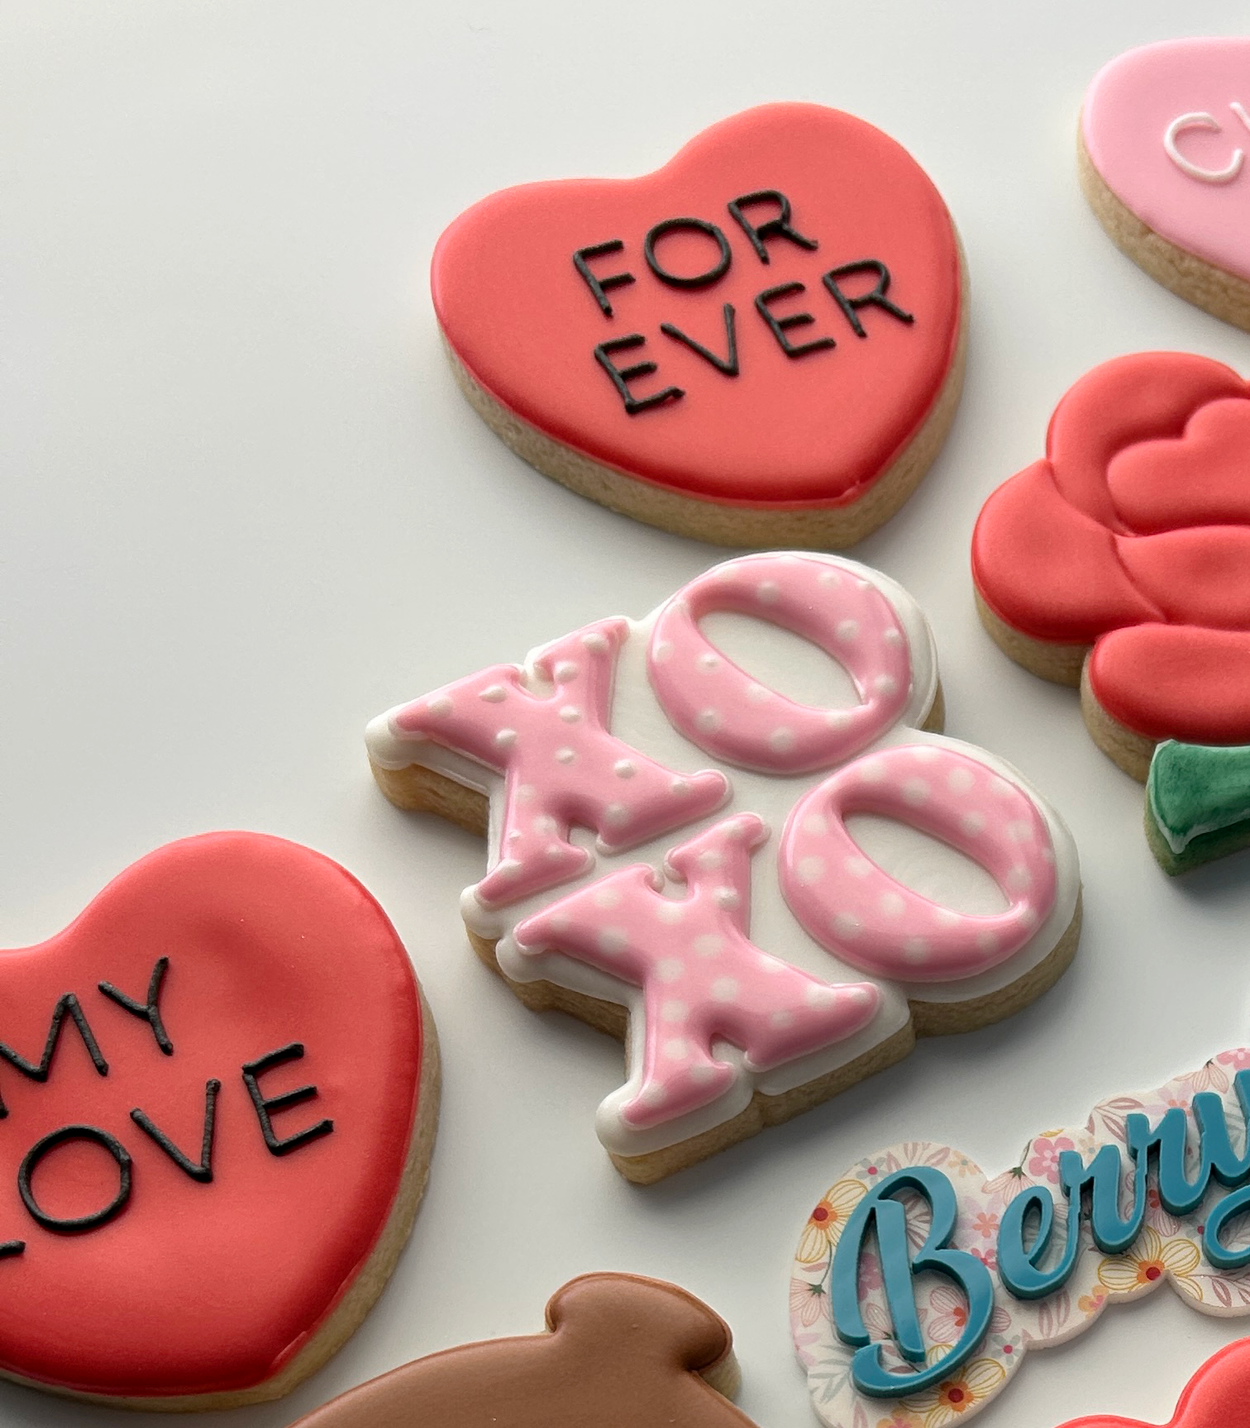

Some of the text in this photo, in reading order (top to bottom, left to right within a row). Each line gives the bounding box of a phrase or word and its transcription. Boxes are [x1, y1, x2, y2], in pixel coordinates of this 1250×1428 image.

[573, 189, 818, 317] FOR
[594, 259, 914, 415] EVER
[0, 955, 174, 1120] MY
[0, 1042, 335, 1260] OVE
